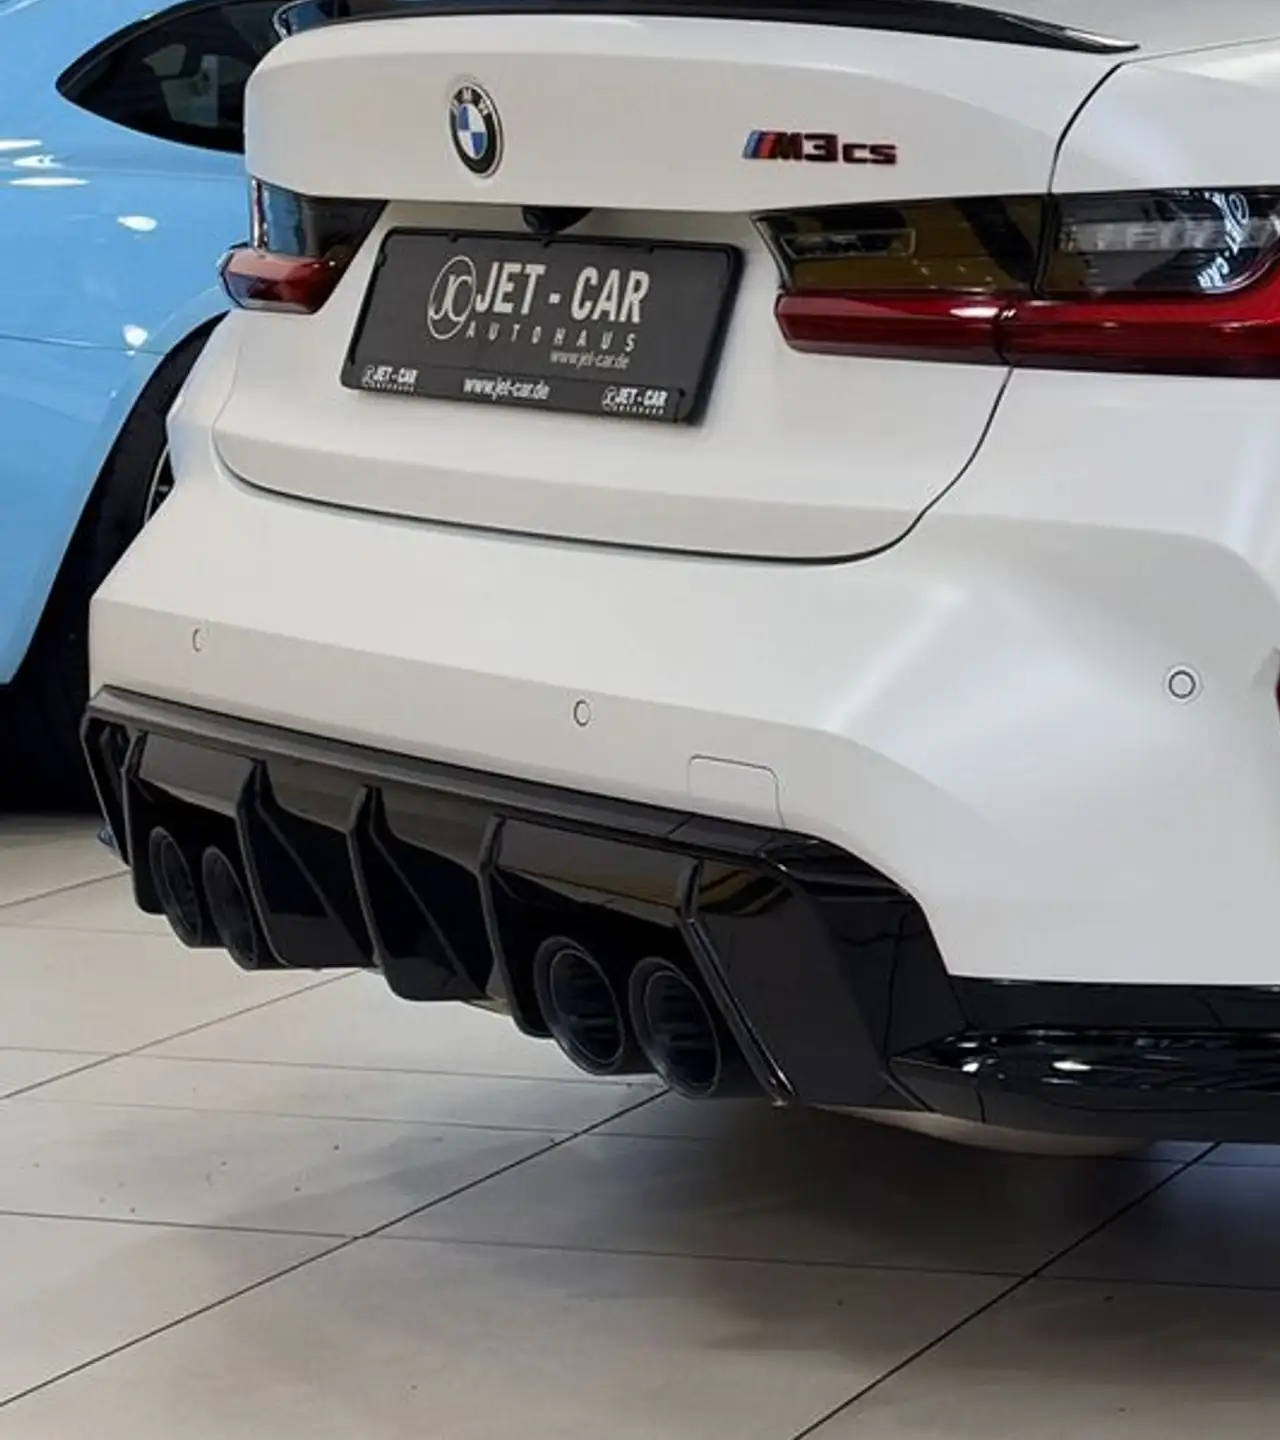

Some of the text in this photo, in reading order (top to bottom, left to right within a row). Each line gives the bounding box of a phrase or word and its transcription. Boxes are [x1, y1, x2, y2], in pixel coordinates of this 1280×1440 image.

[475, 261, 546, 315] JET
[570, 266, 650, 323] CAR
[465, 321, 636, 352] AUTOHAUS
[550, 350, 630, 369] www.jet-car.de
[463, 377, 550, 401] www.jet-car.de
